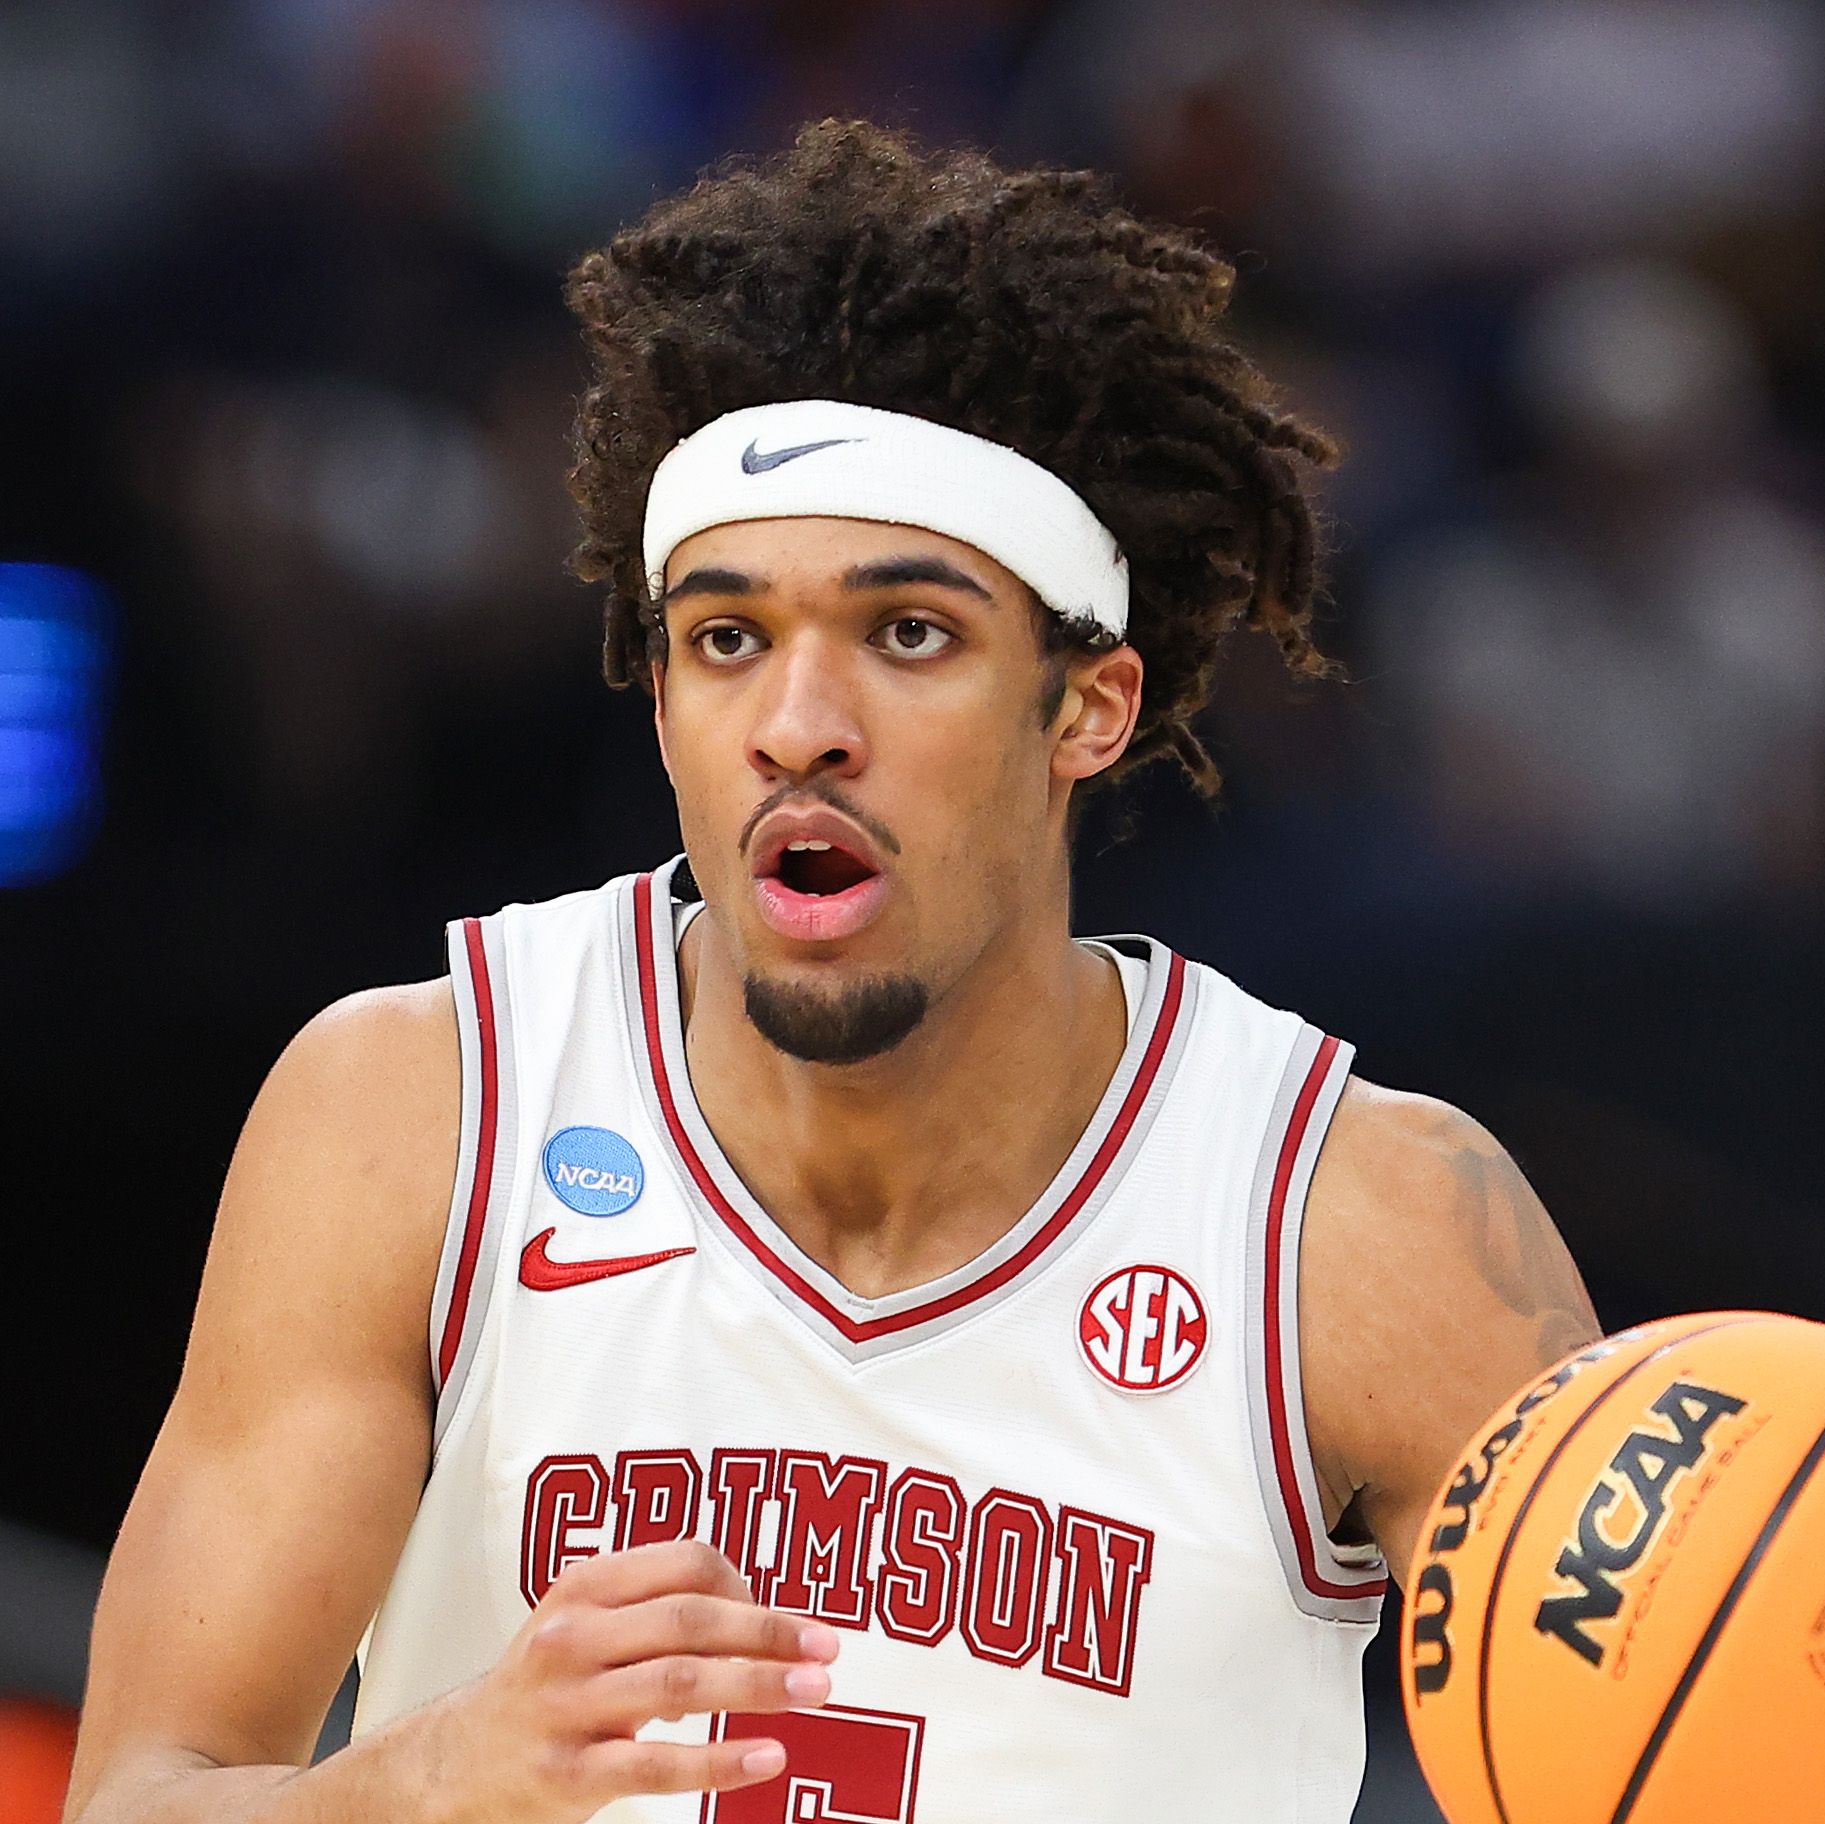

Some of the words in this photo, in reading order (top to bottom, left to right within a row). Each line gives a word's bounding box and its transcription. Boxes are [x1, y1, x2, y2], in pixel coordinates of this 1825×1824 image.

[555, 1161, 637, 1198] NCAA
[1085, 1270, 1201, 1384] SEC
[1533, 1381, 1750, 1671] NCAA
[1668, 1471, 1714, 1547] GAME
[1716, 1413, 1774, 1469] BALL
[520, 1447, 1155, 1698] CRIMSON
